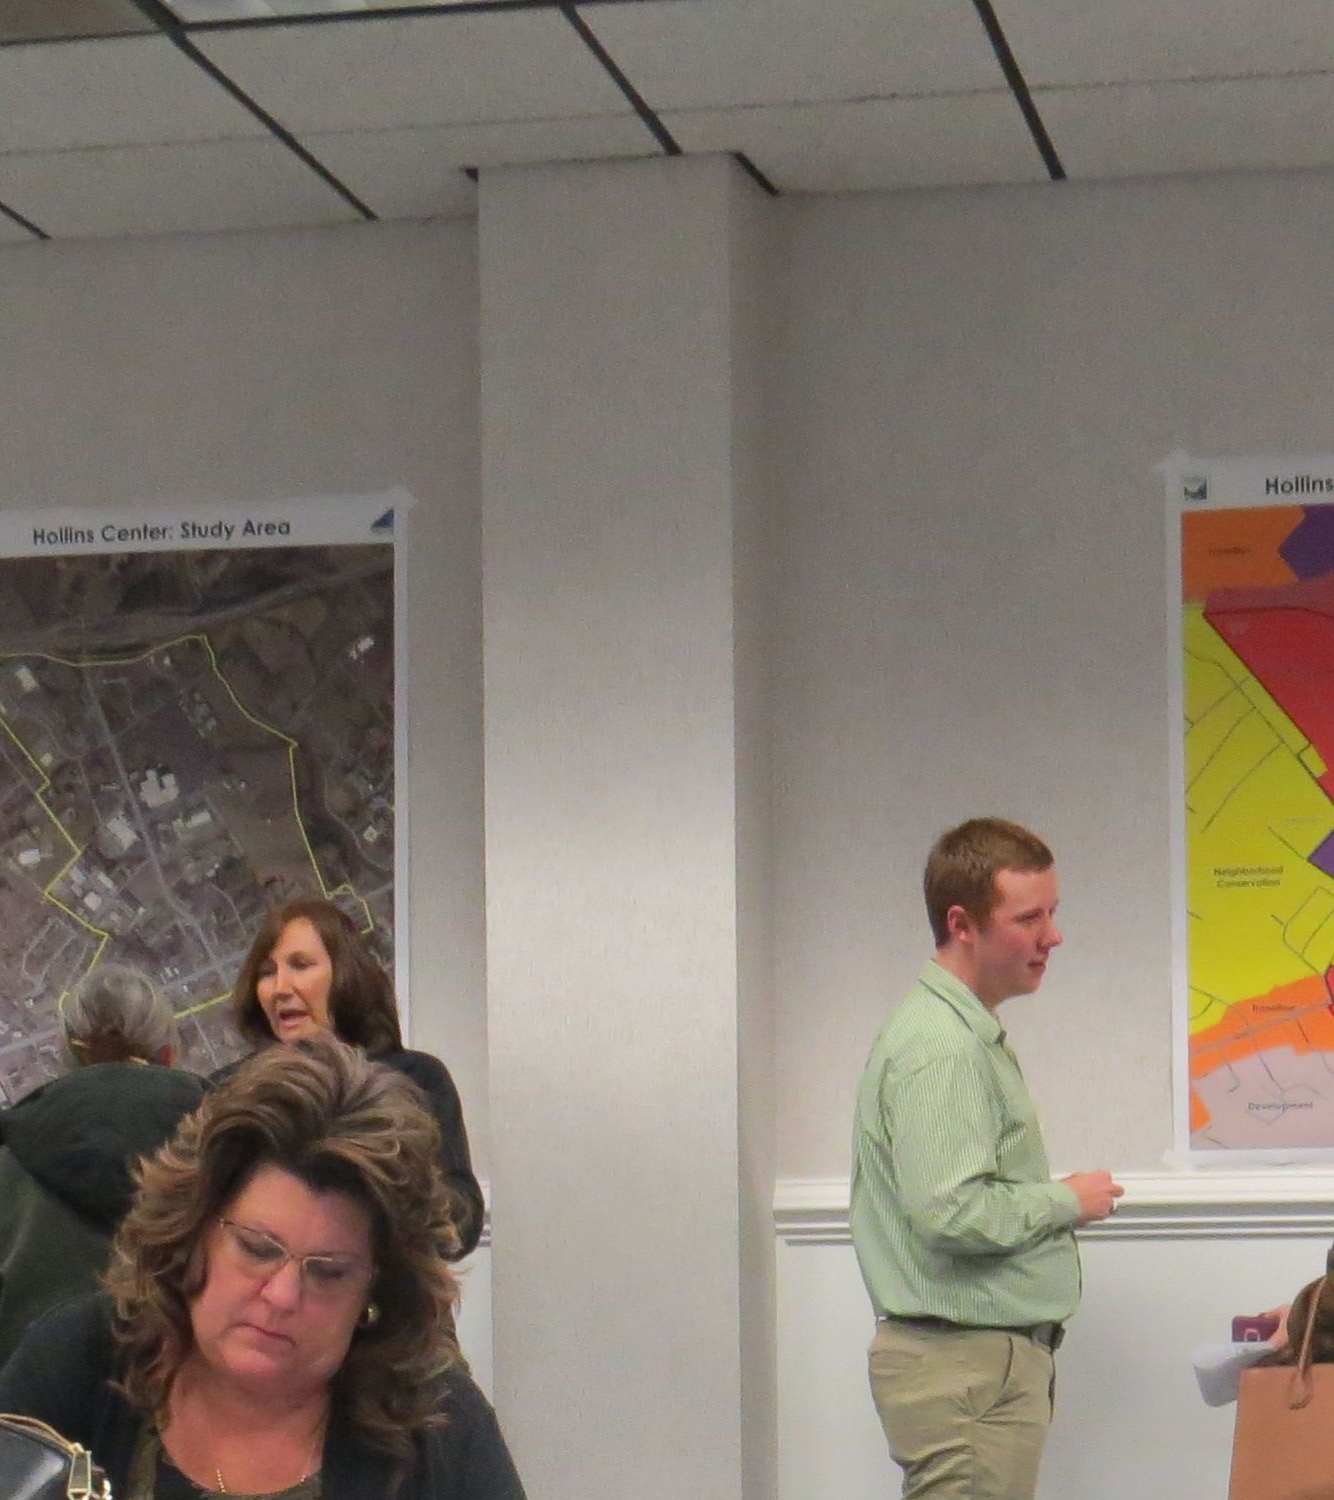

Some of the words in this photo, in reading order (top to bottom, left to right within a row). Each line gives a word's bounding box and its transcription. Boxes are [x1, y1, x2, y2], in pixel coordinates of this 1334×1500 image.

[1266, 476, 1334, 496] Hollins
[33, 527, 95, 546] Hollins
[101, 523, 173, 543] Center:
[181, 520, 235, 541] Study
[243, 519, 291, 537] Area
